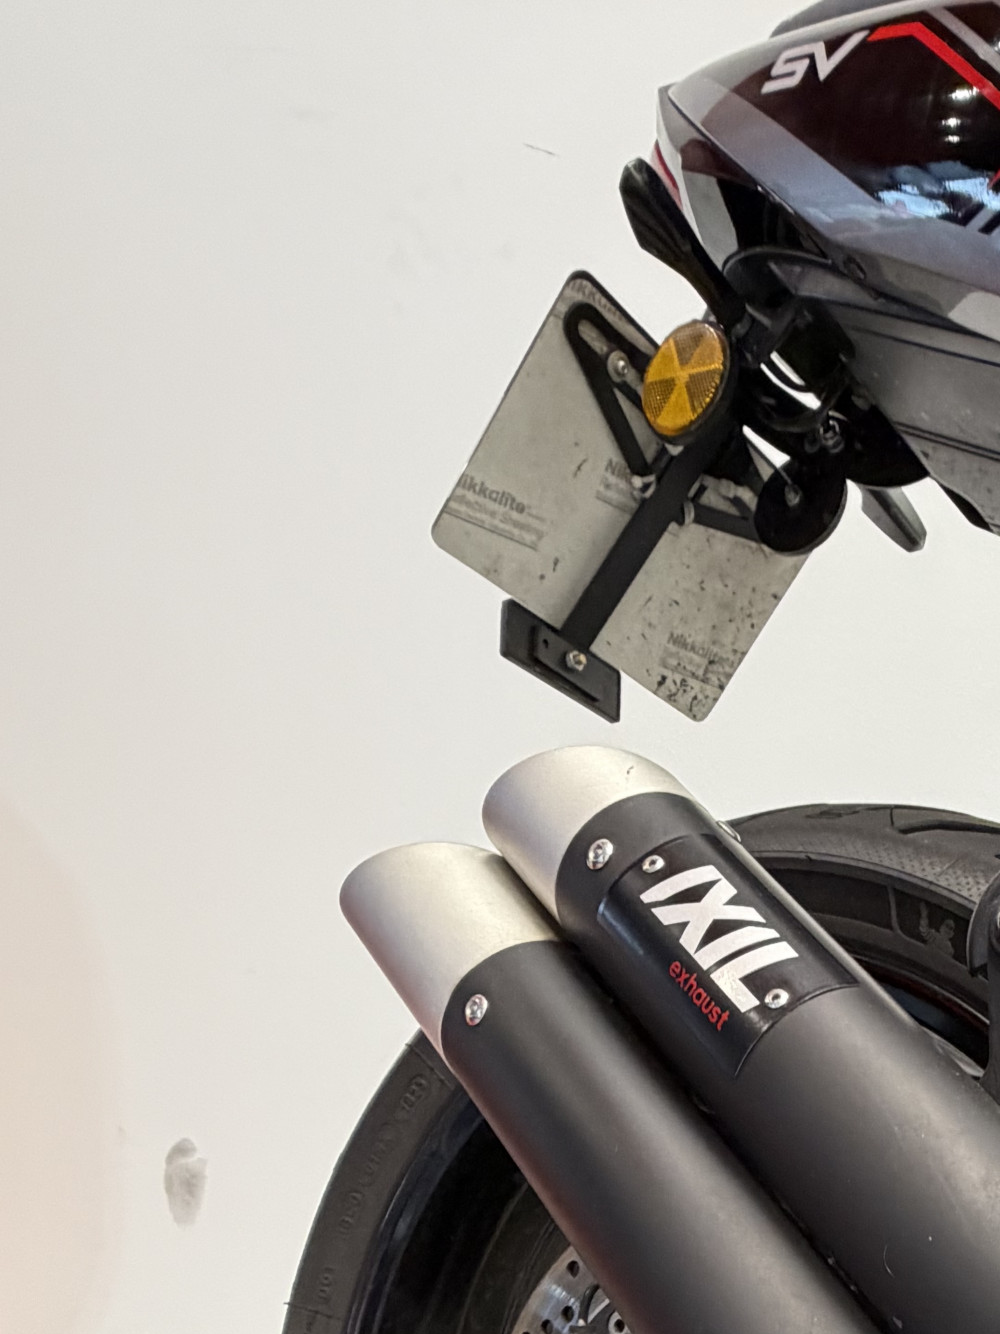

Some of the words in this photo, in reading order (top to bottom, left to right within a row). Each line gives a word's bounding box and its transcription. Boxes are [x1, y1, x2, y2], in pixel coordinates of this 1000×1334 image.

[761, 30, 870, 95] SV
[639, 865, 799, 1013] IXIL
[669, 961, 730, 1031] exhaust
